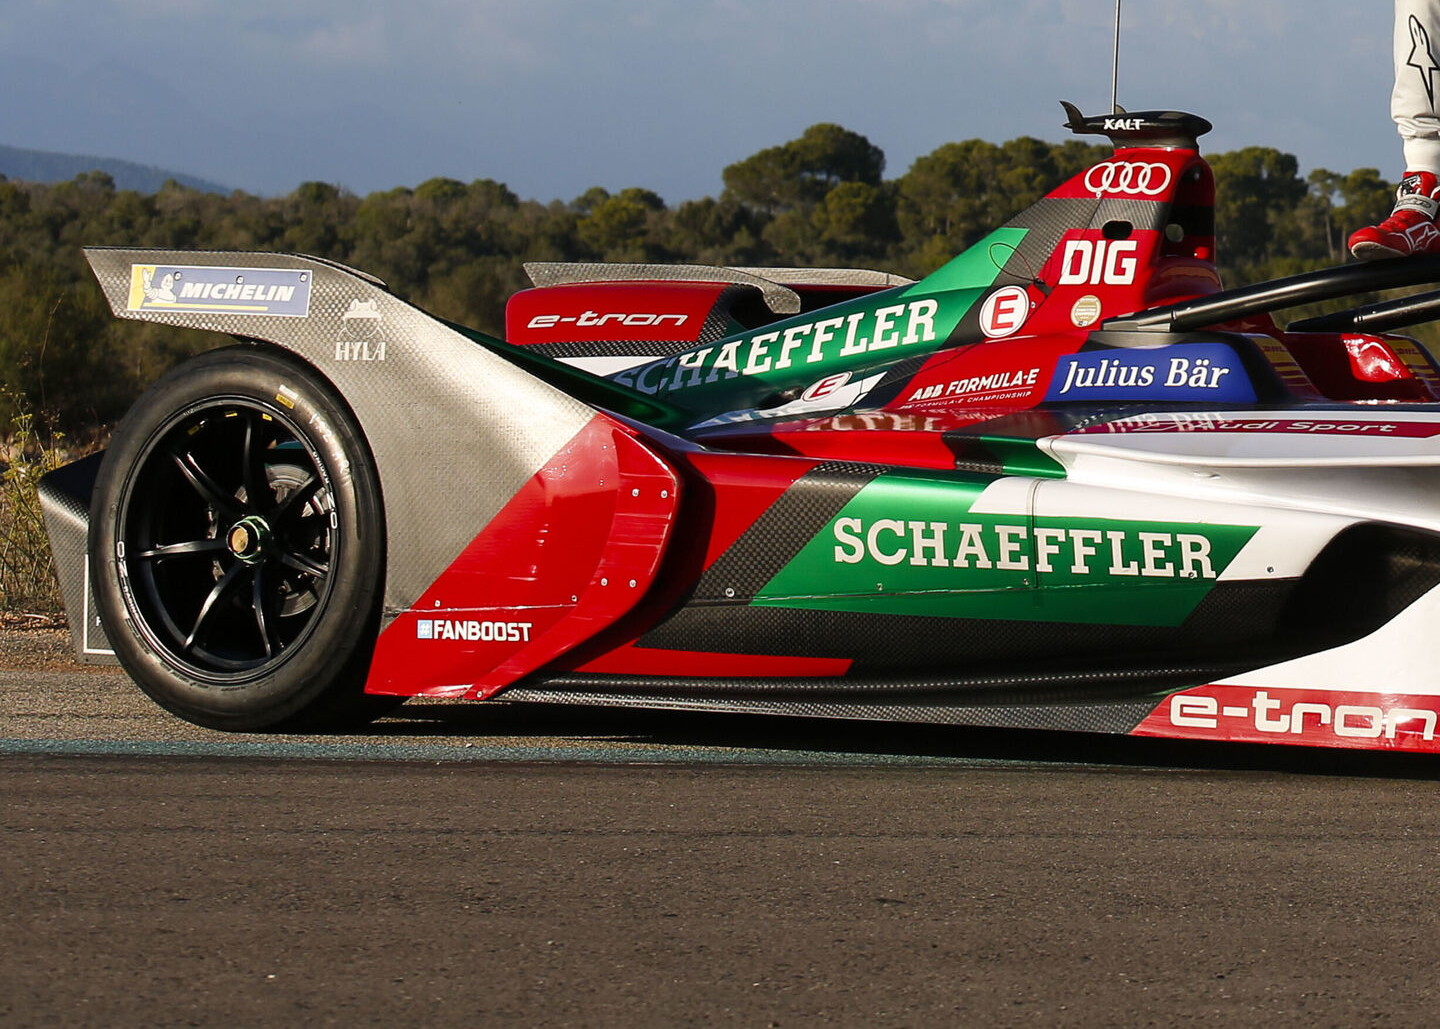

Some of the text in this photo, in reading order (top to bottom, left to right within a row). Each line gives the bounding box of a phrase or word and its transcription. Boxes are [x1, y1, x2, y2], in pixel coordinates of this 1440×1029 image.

[1058, 240, 1138, 285] DIG
[179, 282, 296, 302] MICHELIN
[527, 310, 689, 329] e-tron
[335, 341, 386, 361] HYLA
[1059, 358, 1229, 394] Julius Bär
[908, 384, 944, 402] ABB
[966, 391, 1032, 403] CHAMPIONSHIP
[1286, 421, 1397, 433] Sport
[833, 518, 1216, 578] SCHAEFFLER
[1170, 690, 1438, 741] e-tron
